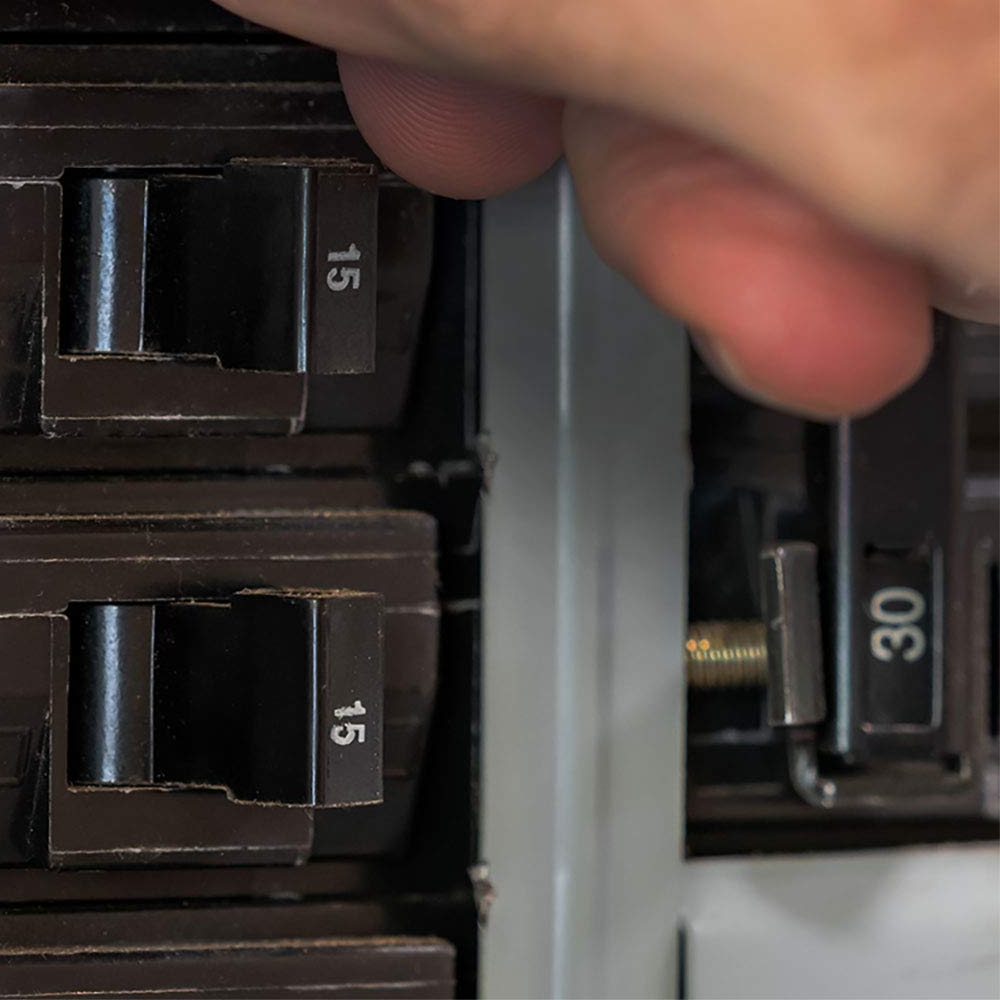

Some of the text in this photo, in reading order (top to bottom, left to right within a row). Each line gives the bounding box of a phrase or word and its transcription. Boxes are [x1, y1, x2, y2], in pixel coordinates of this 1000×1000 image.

[326, 243, 361, 291] 15
[871, 586, 926, 662] 30
[330, 700, 366, 746] 15
